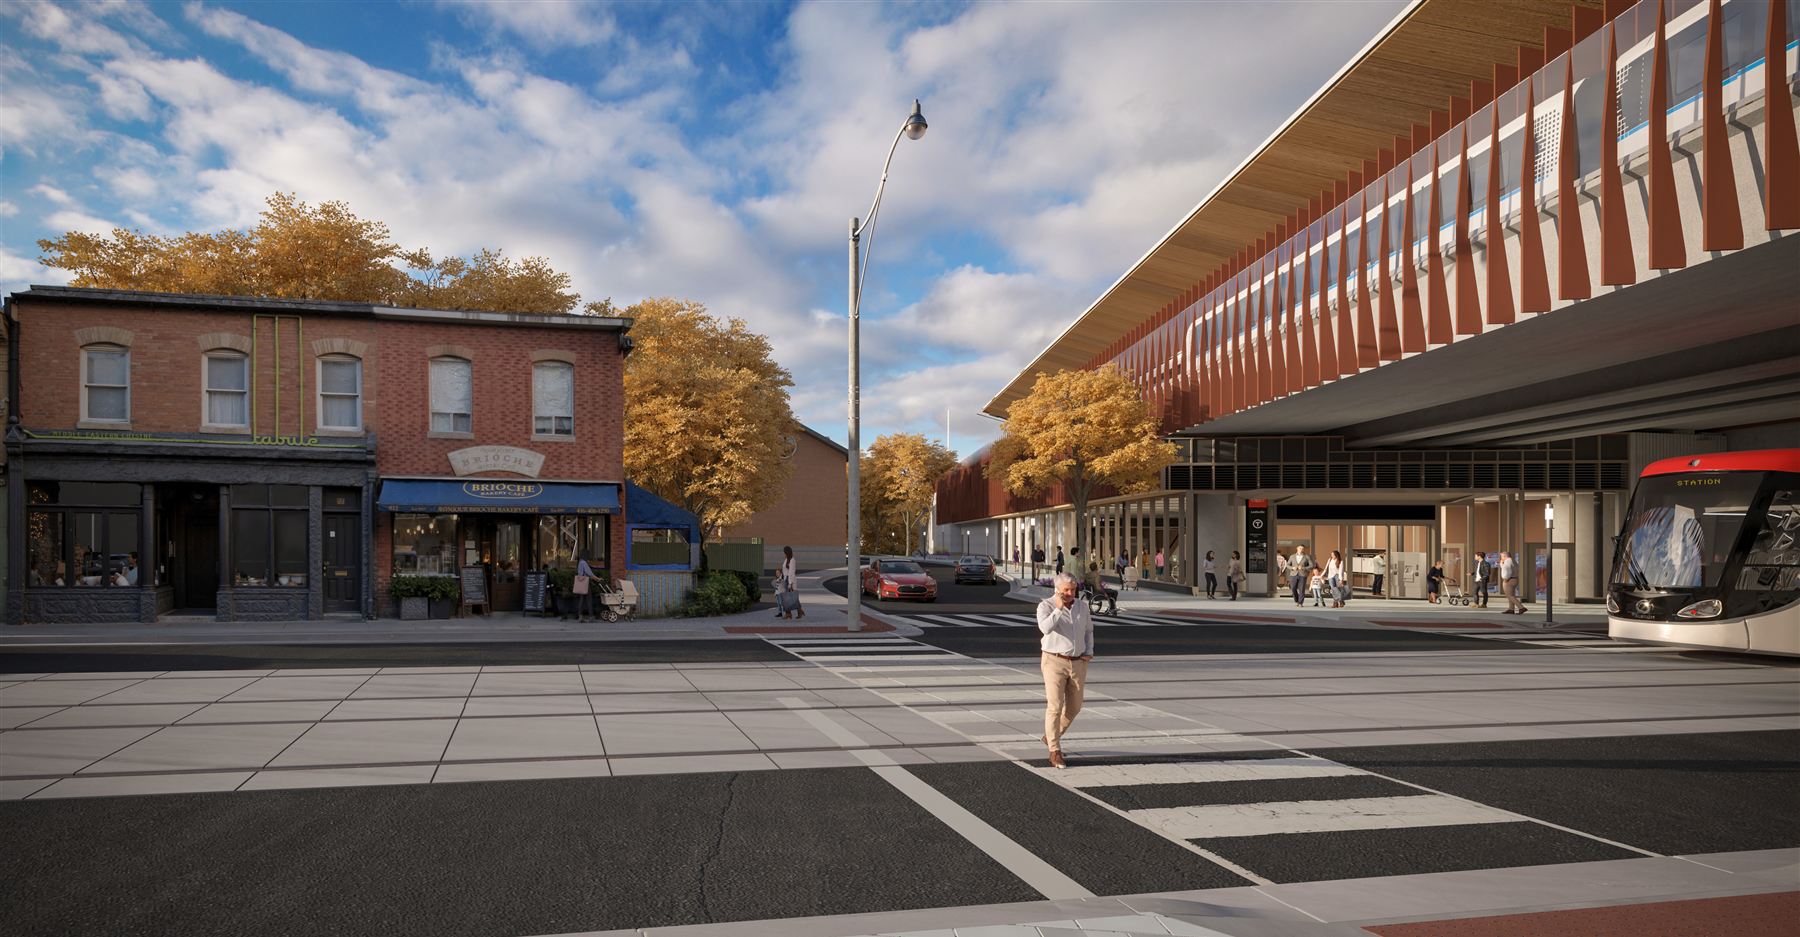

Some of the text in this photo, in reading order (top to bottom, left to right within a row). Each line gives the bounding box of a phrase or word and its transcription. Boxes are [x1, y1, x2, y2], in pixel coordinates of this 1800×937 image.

[462, 454, 534, 468] BRIOCHE
[1677, 478, 1721, 487] STATION
[472, 483, 535, 493] BRIOCHE
